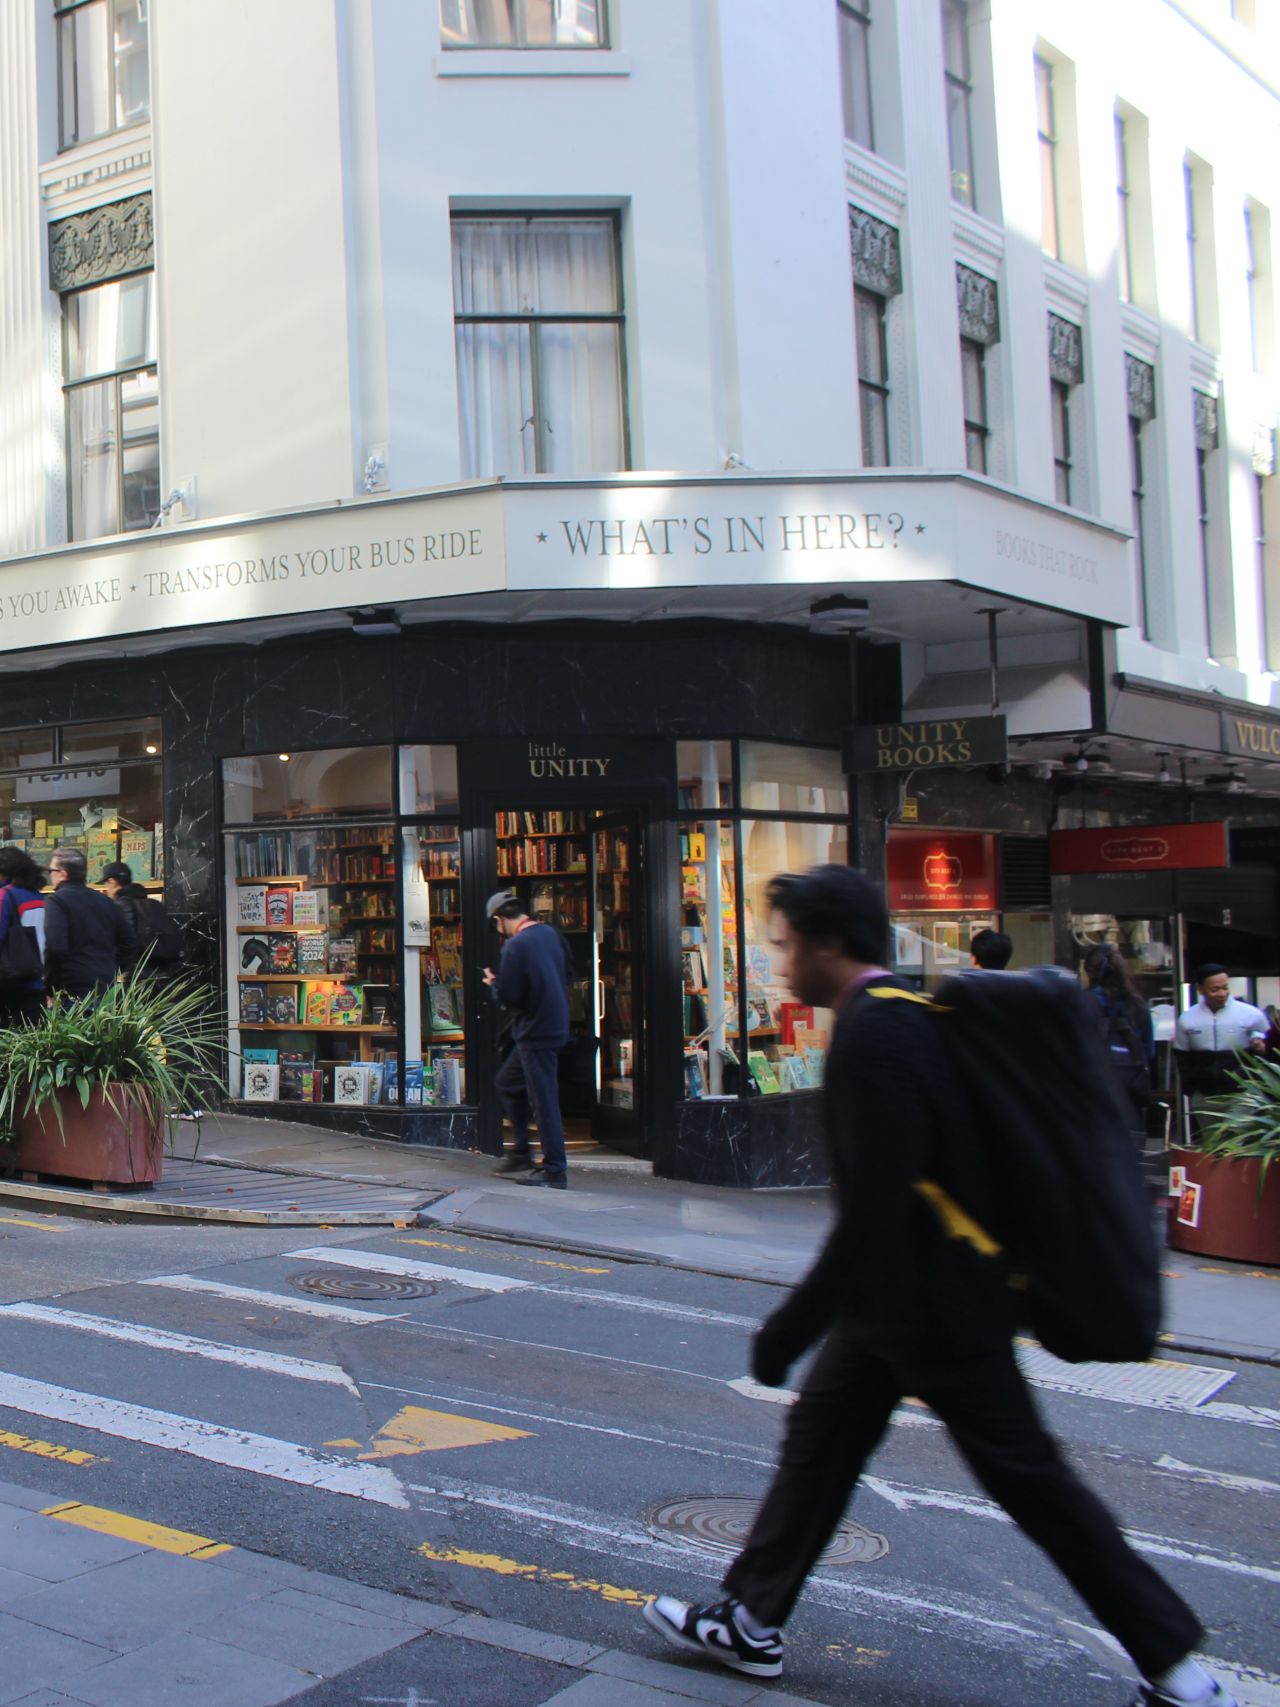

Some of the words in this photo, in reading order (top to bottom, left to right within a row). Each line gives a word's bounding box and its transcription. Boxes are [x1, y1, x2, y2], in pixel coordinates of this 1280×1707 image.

[560, 516, 713, 556] WHAT'S
[724, 514, 767, 554] IN
[778, 512, 904, 552] HERE?
[995, 529, 1037, 567] BOOKS
[9, 589, 50, 618] YOU
[54, 577, 122, 612] AWAKE
[144, 553, 290, 597] TRANSFORMS
[294, 544, 363, 577] YOUR
[370, 537, 416, 569] BUS
[423, 529, 483, 562] RIDE
[876, 719, 970, 748] UNITY
[528, 742, 566, 758] little
[877, 741, 972, 769] BOOKS
[528, 758, 611, 778] UNITY
[126, 841, 147, 851] MAPS
[302, 951, 324, 961] 2024
